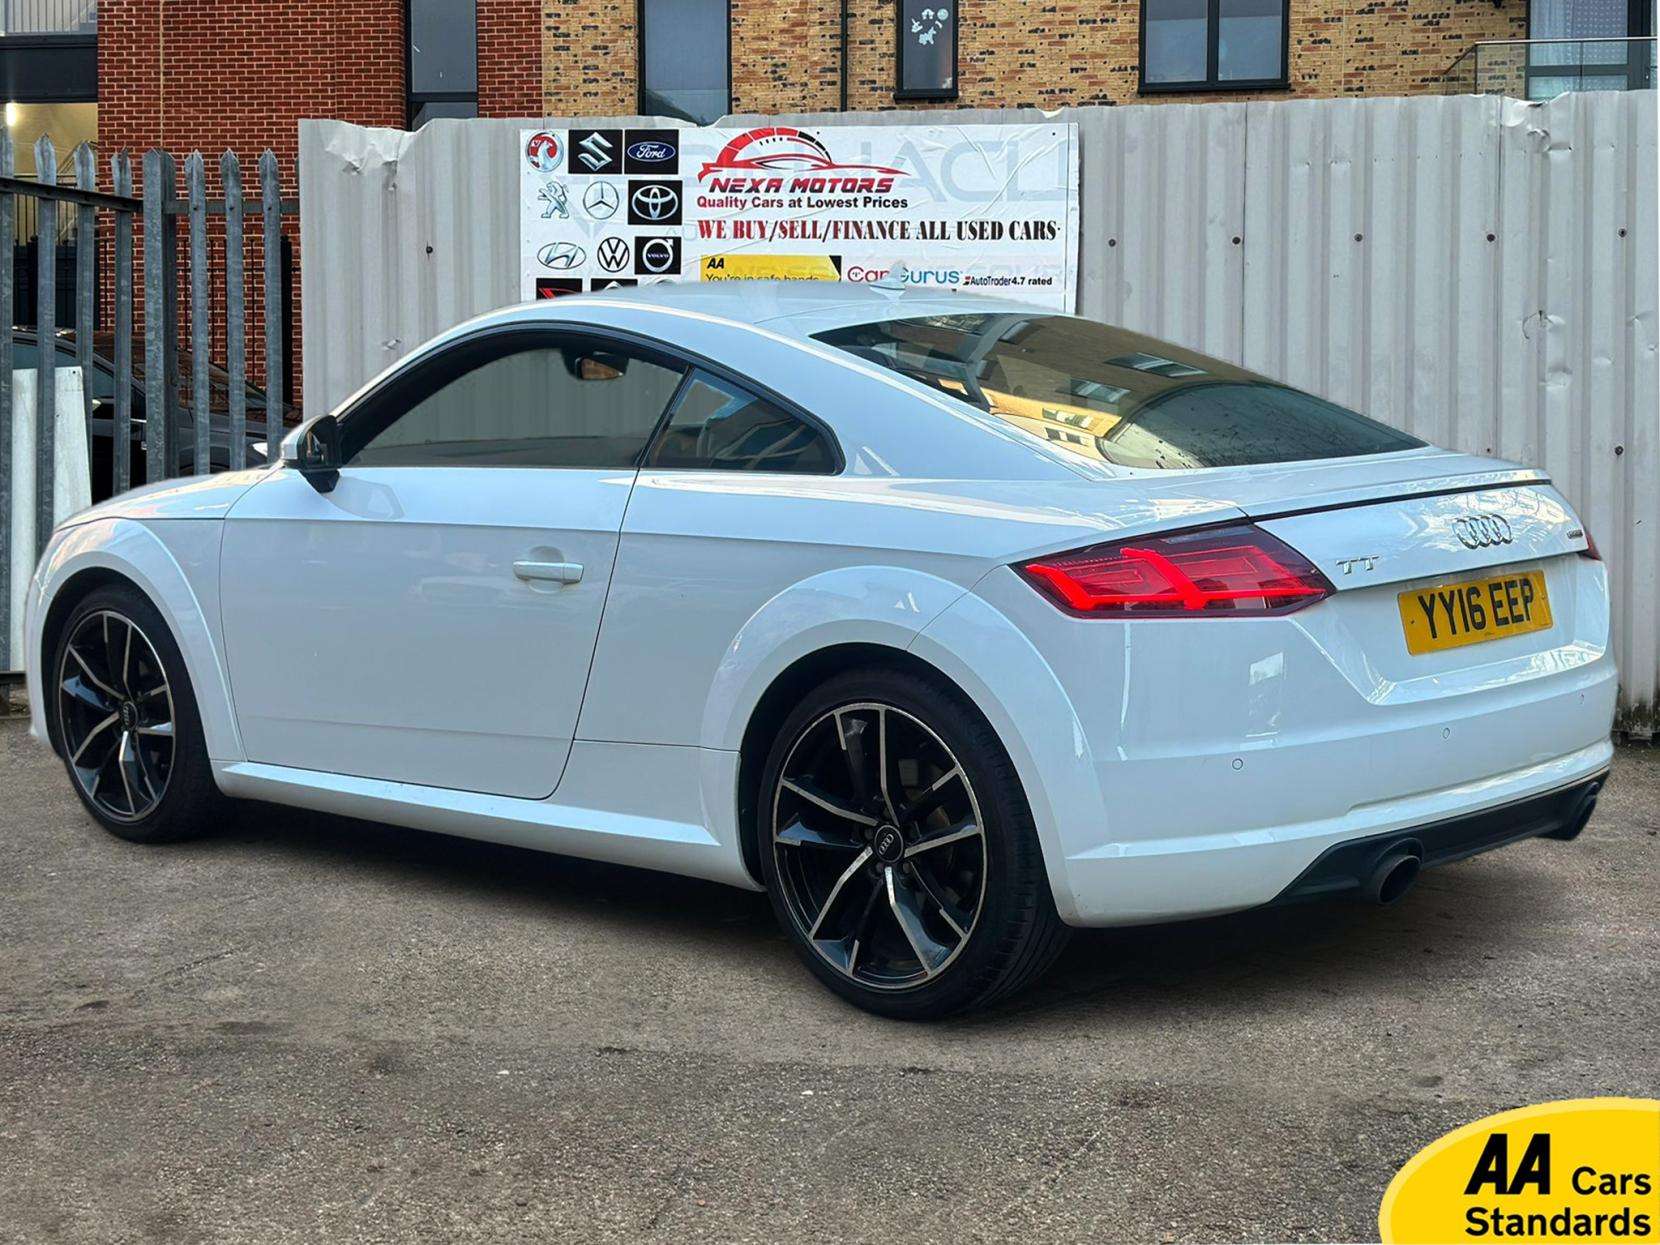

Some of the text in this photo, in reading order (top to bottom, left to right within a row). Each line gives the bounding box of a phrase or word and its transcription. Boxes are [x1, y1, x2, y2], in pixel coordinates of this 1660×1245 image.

[636, 144, 666, 159] Ford
[708, 177, 895, 194] NEXA MOTORS
[696, 195, 908, 211] Quality Cars at Lowest Prices
[697, 219, 727, 240] WE
[732, 219, 911, 242] BUY/SELL/FINANCE
[915, 220, 951, 240] ALL
[956, 220, 1004, 240] USED
[1008, 220, 1057, 240] CARS
[706, 257, 725, 269] AA
[970, 275, 1053, 286] AutoTrader 4.7 rated
[1336, 555, 1380, 575] TT
[1417, 577, 1534, 639] YY16 EEP
